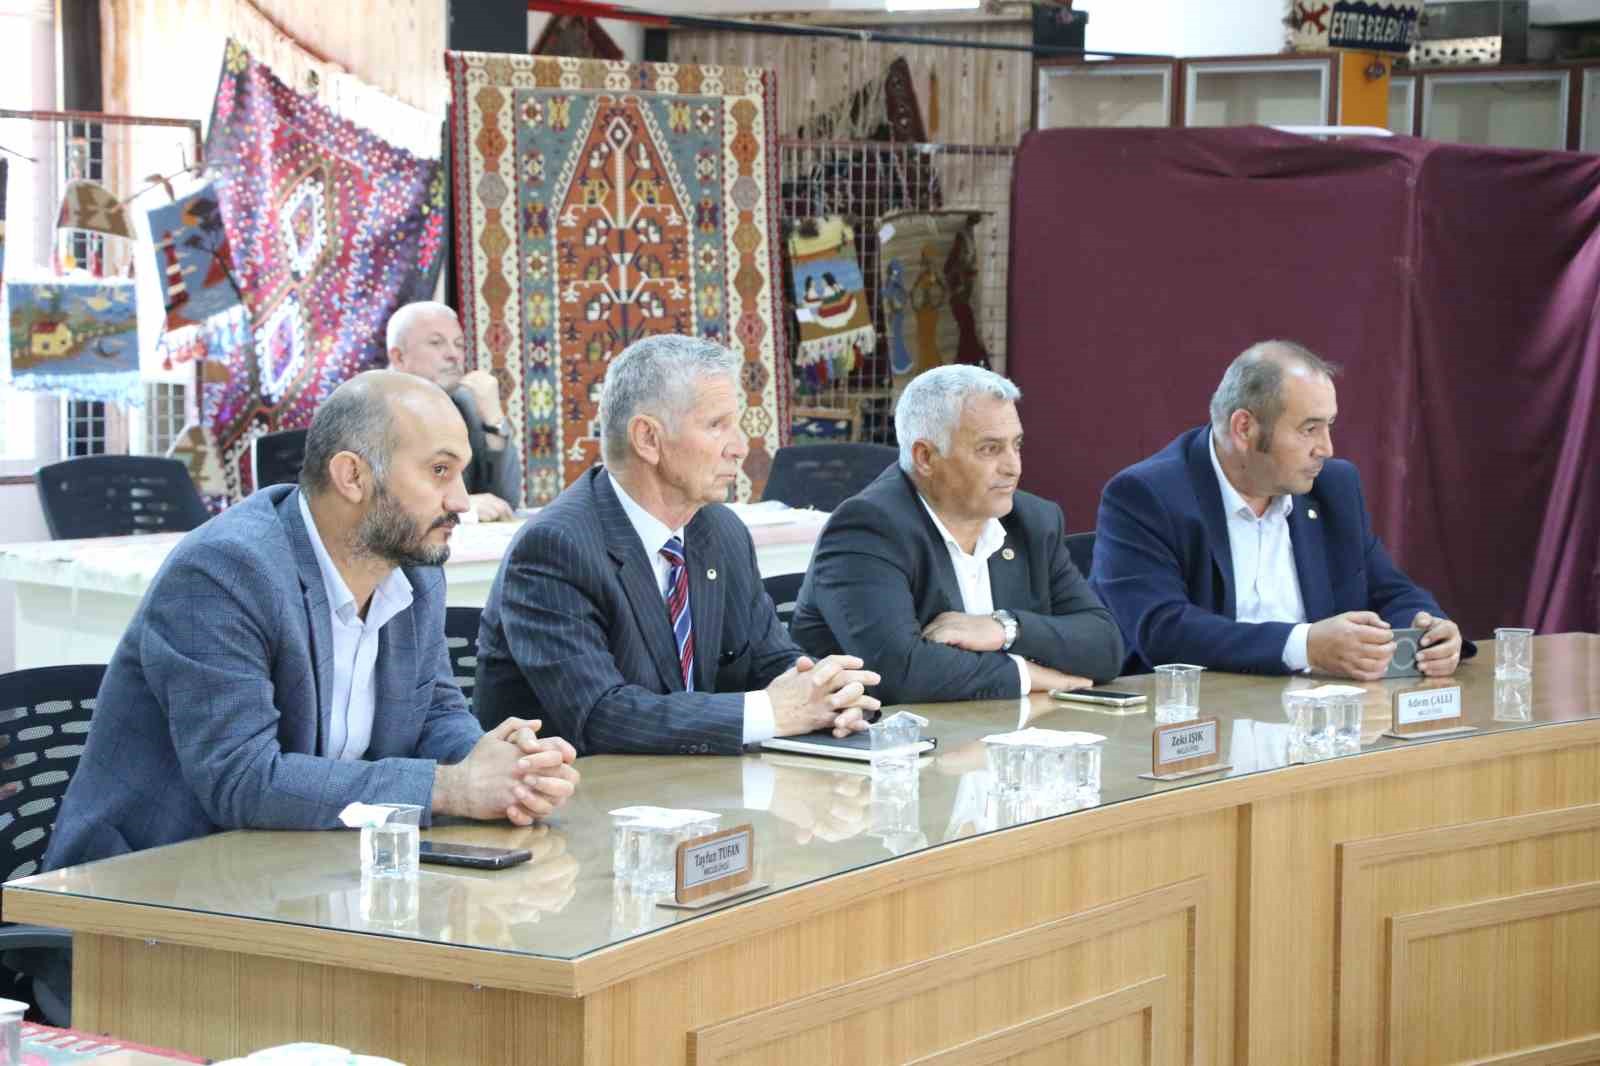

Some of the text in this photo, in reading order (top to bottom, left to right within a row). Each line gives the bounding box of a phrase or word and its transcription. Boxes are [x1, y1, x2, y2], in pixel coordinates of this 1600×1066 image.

[1171, 732, 1188, 746] Zeki
[694, 844, 740, 868] Tayfun TUFAN
